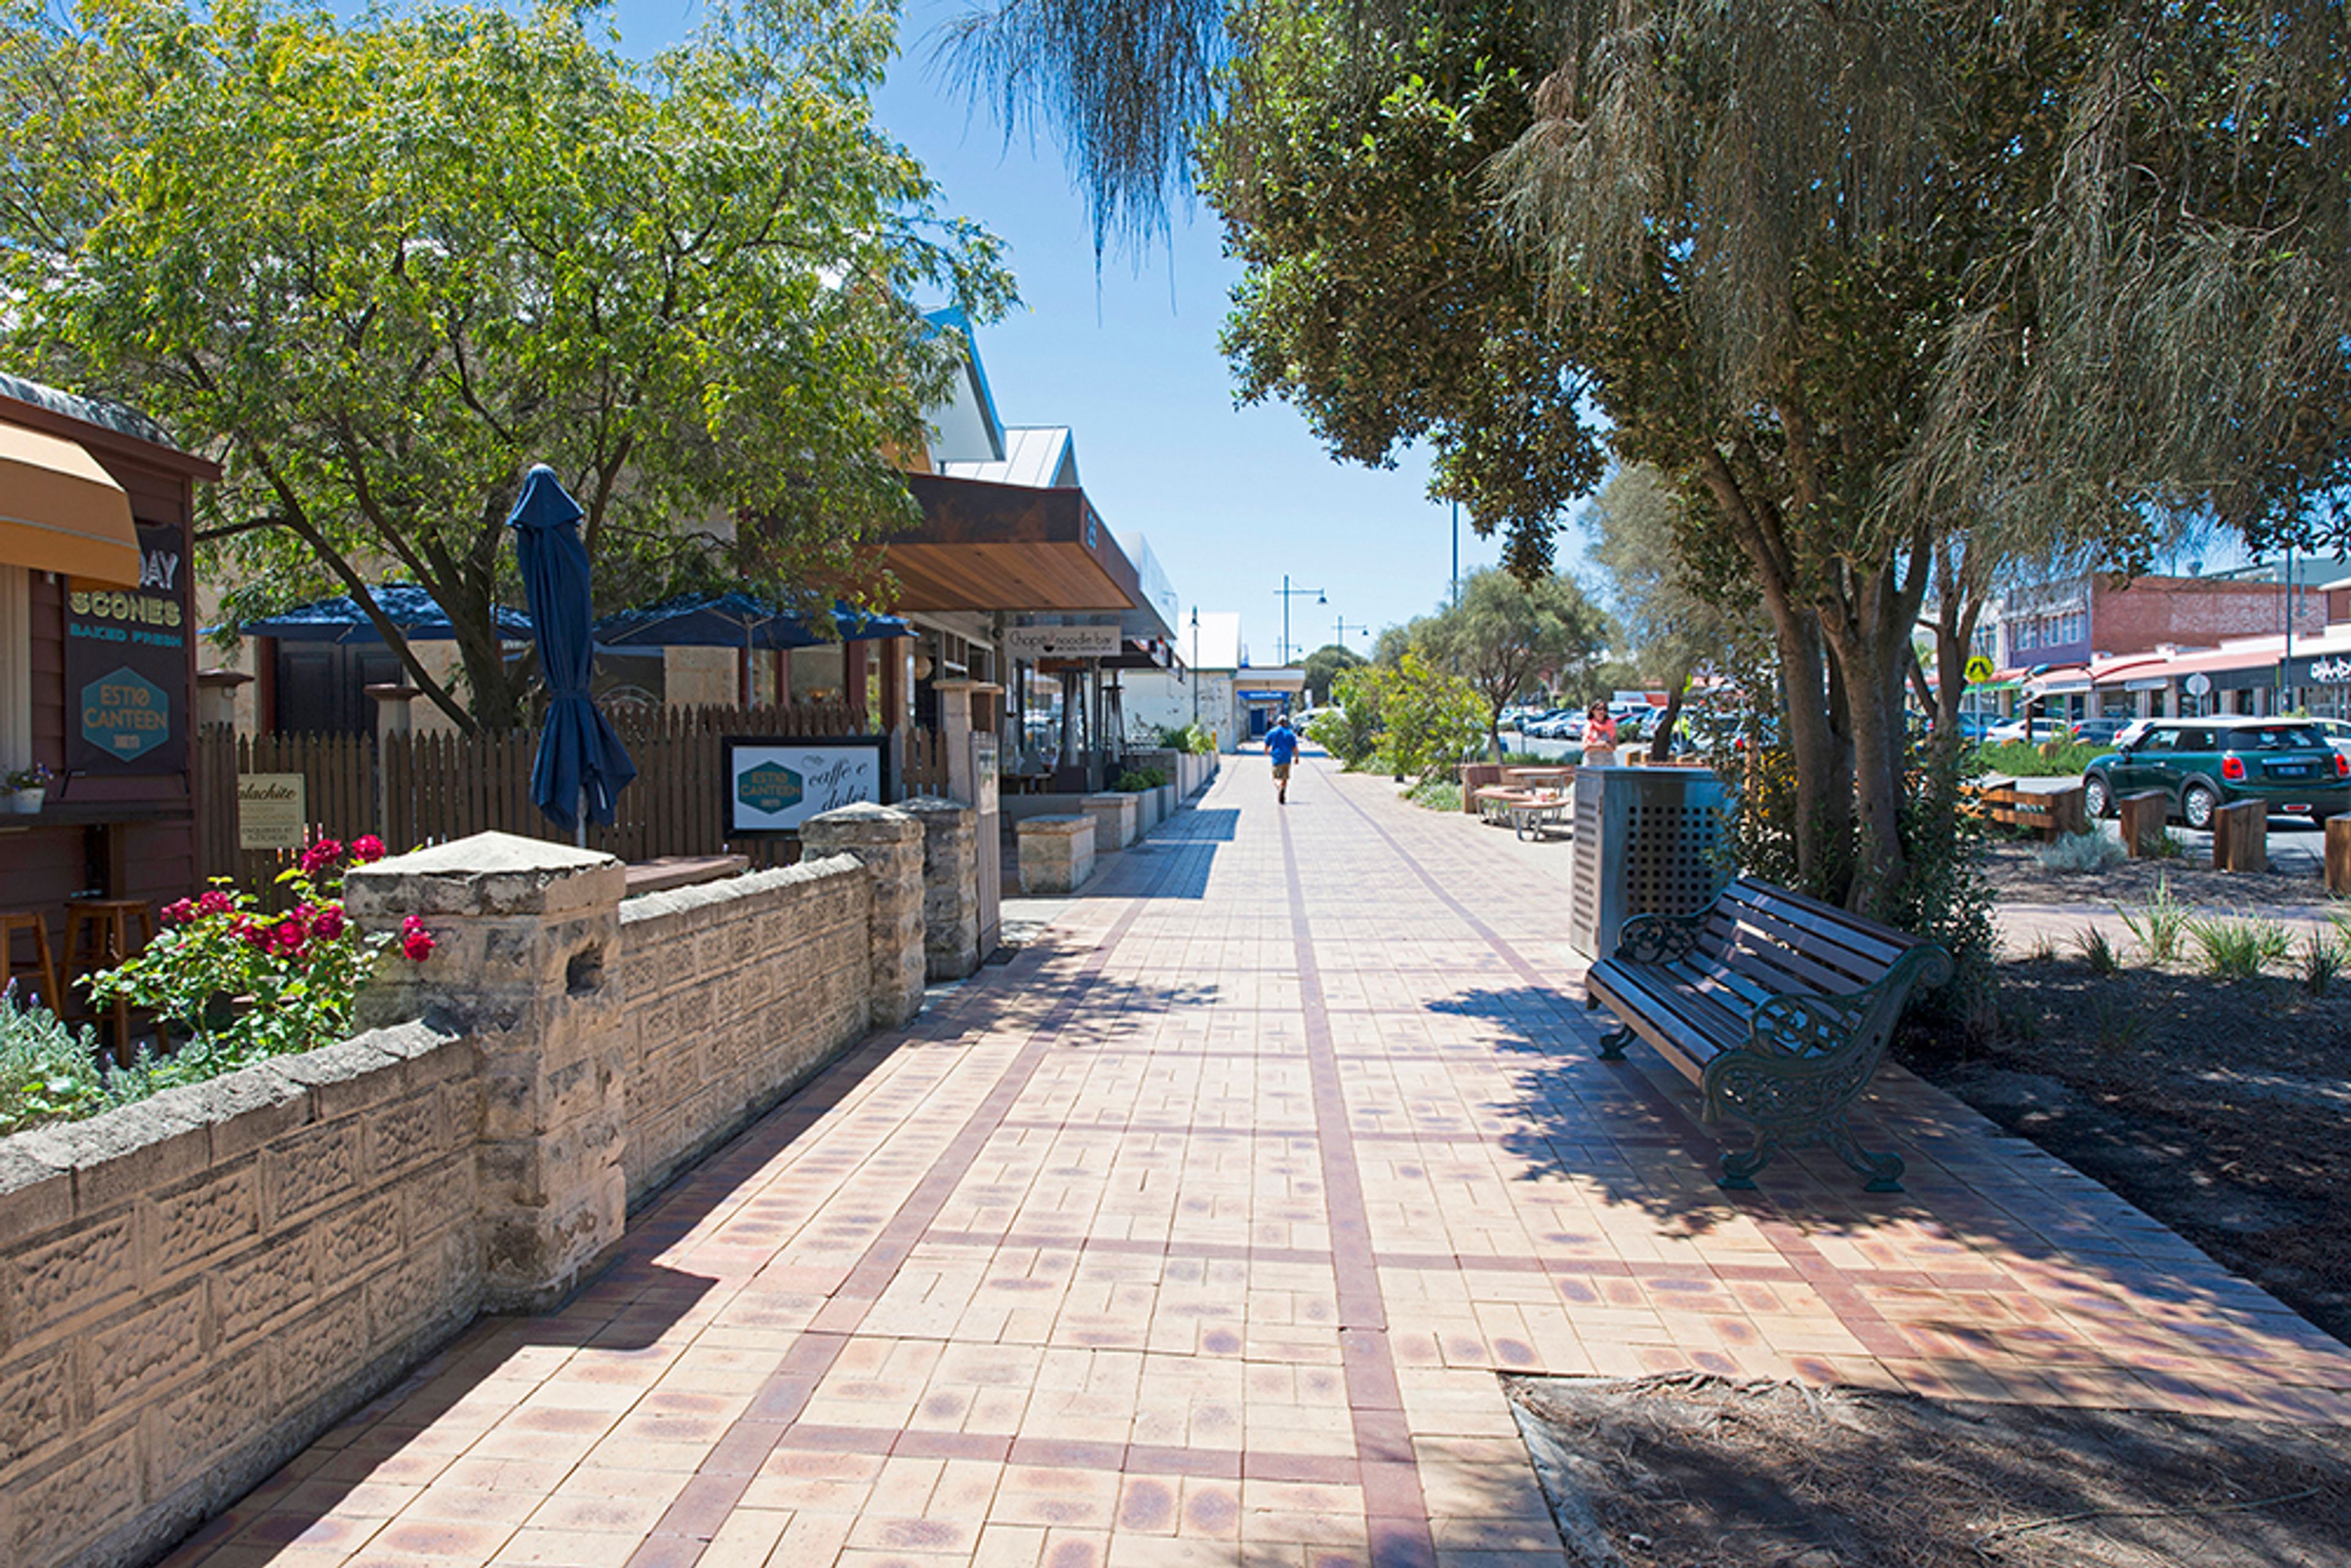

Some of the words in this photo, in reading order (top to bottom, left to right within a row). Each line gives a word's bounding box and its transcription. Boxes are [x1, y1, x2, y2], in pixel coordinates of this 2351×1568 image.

[70, 591, 181, 627] SCONES
[70, 623, 127, 642] BAKED
[132, 631, 182, 648] FRESH
[1056, 632, 1092, 645] noodle
[1095, 632, 1112, 645] bar
[83, 707, 167, 730] CANTEEN
[739, 784, 801, 797] CANTEEN
